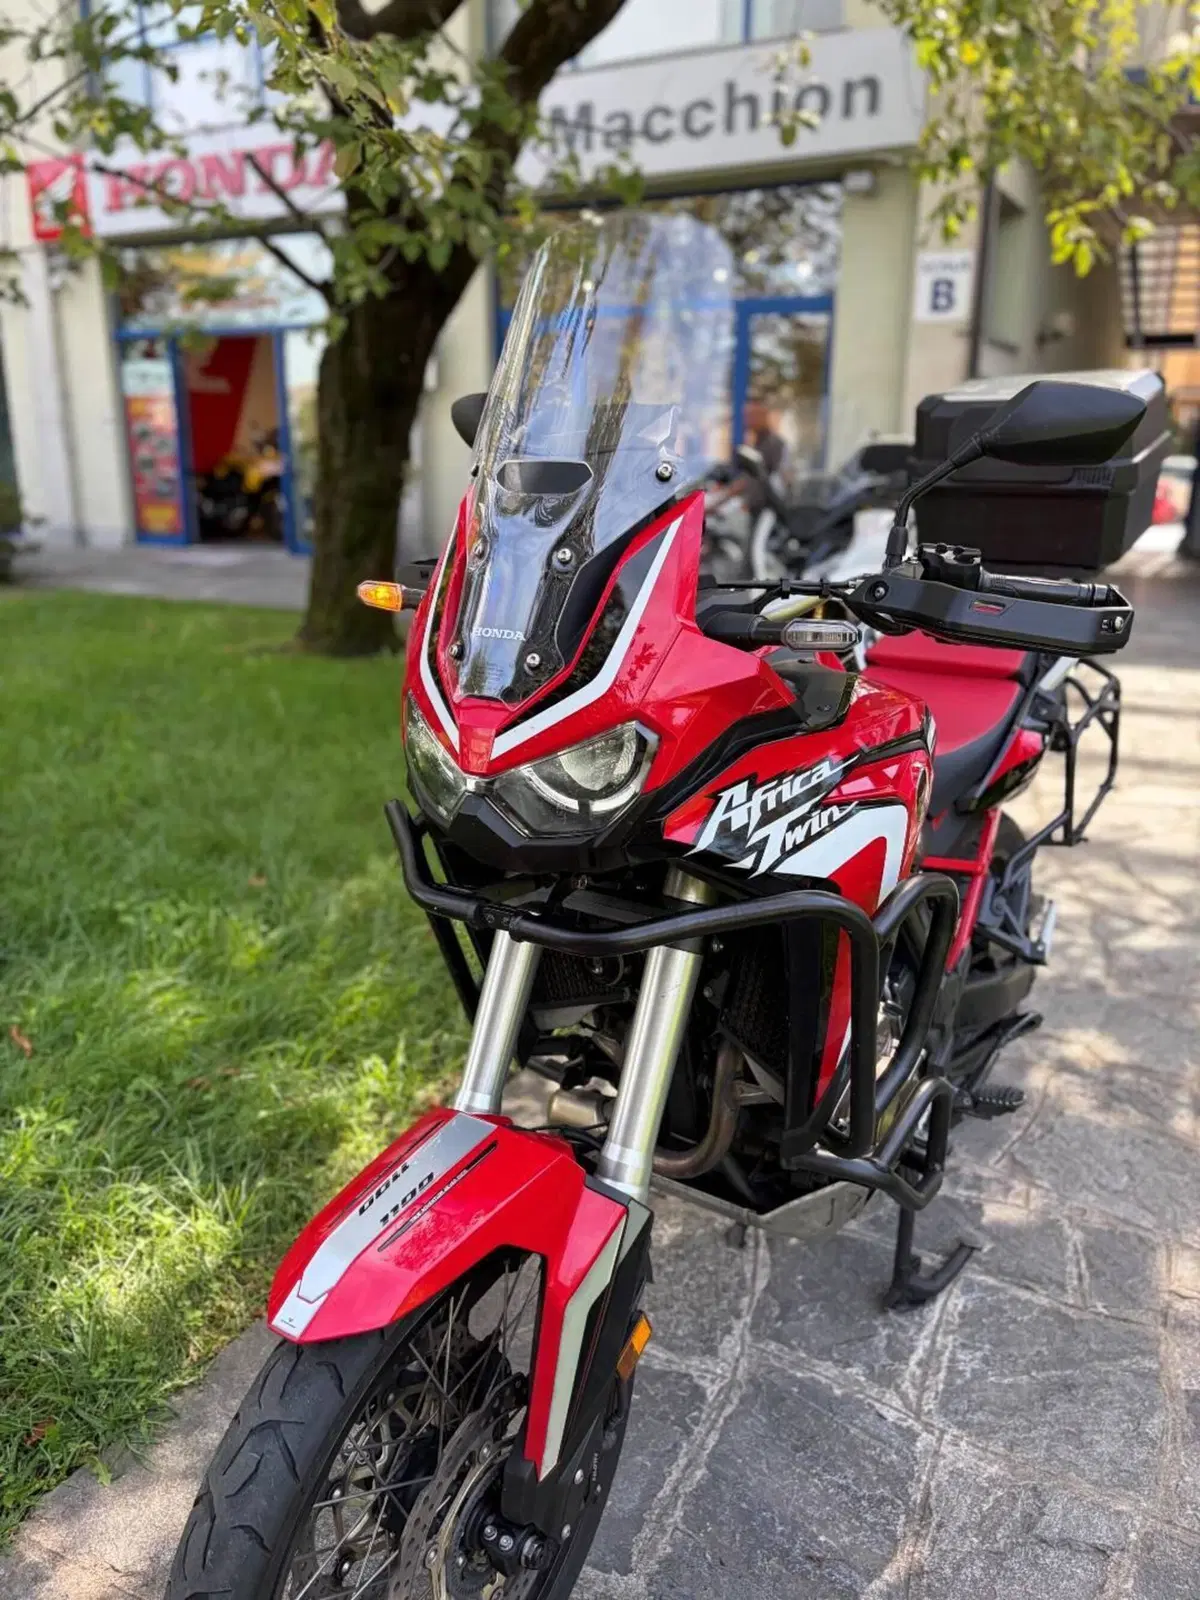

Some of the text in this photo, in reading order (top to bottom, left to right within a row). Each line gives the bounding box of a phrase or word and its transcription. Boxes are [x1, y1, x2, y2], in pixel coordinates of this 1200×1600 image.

[548, 73, 881, 153] Macchion
[931, 278, 955, 312] B
[471, 627, 526, 641] HONDA
[682, 754, 860, 857] Africa
[723, 791, 858, 879] Twin
[379, 1172, 434, 1227] 1100
